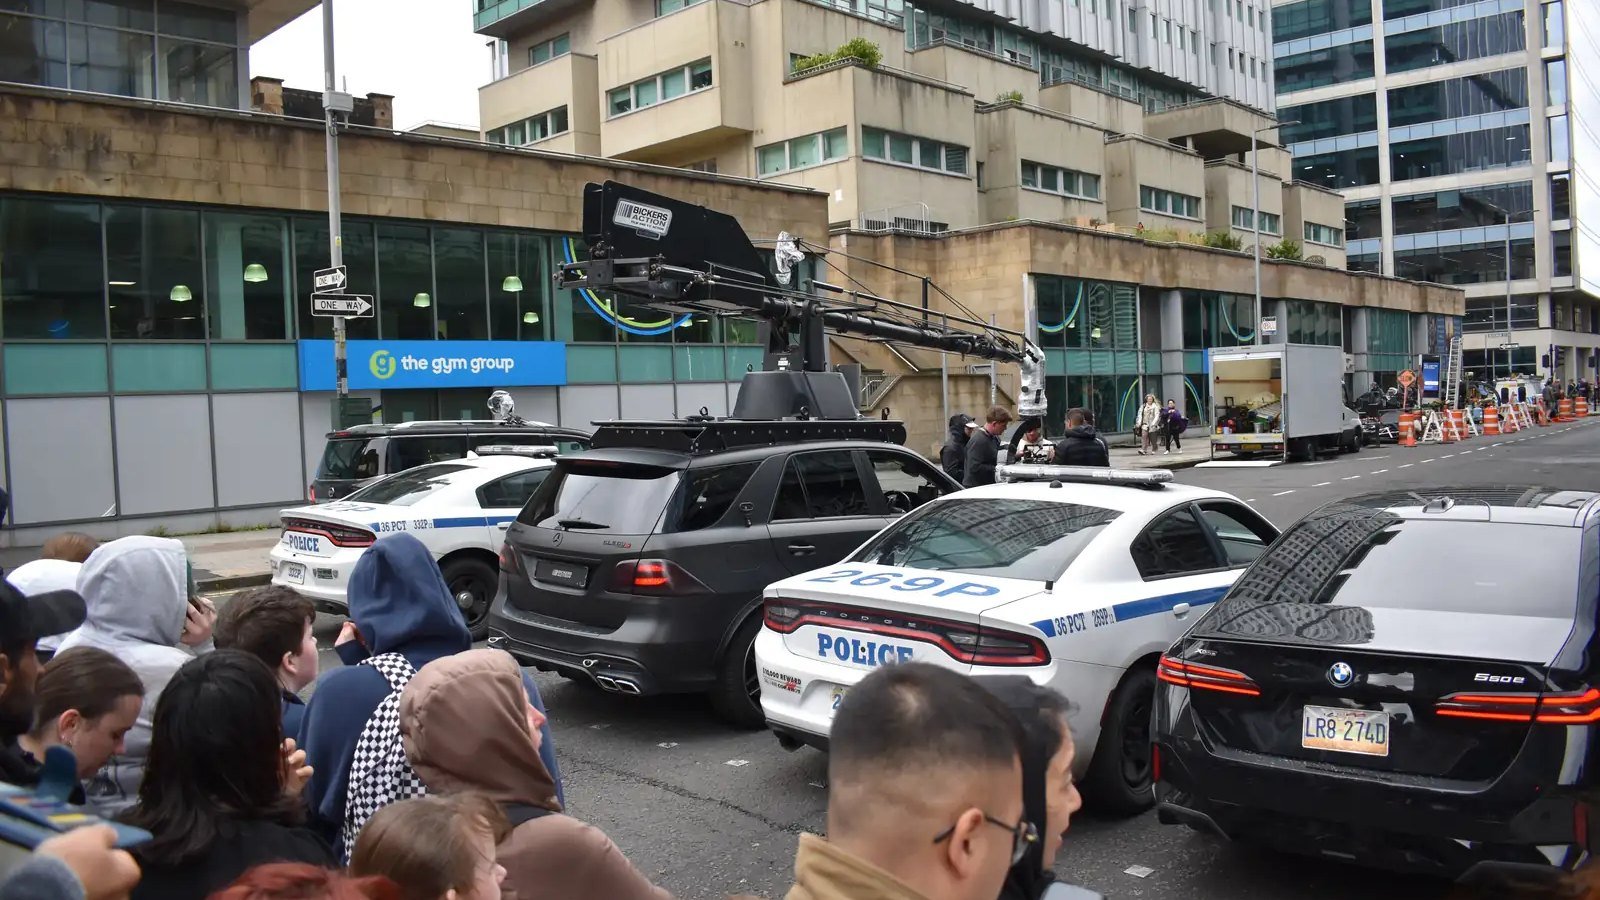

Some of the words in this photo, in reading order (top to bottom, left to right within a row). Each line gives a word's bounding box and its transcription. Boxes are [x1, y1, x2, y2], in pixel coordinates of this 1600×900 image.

[631, 214, 667, 227] ACTION
[632, 206, 668, 221] BICKERS
[318, 276, 328, 286] ONE
[320, 300, 337, 310] ONE
[345, 301, 364, 310] WAY
[400, 354, 429, 370] the
[432, 357, 468, 374] gym
[470, 357, 515, 374] group
[380, 521, 391, 533] 36
[391, 520, 407, 532] PCT
[412, 518, 429, 530] 332P
[288, 534, 320, 553] POLICE
[805, 569, 1001, 598] 269P
[1054, 616, 1068, 636] 36
[1066, 612, 1087, 634] PCT
[817, 633, 914, 667] POLICE
[779, 673, 802, 685] REWARD
[1305, 716, 1337, 740] LR8
[1343, 720, 1387, 745] 274D
